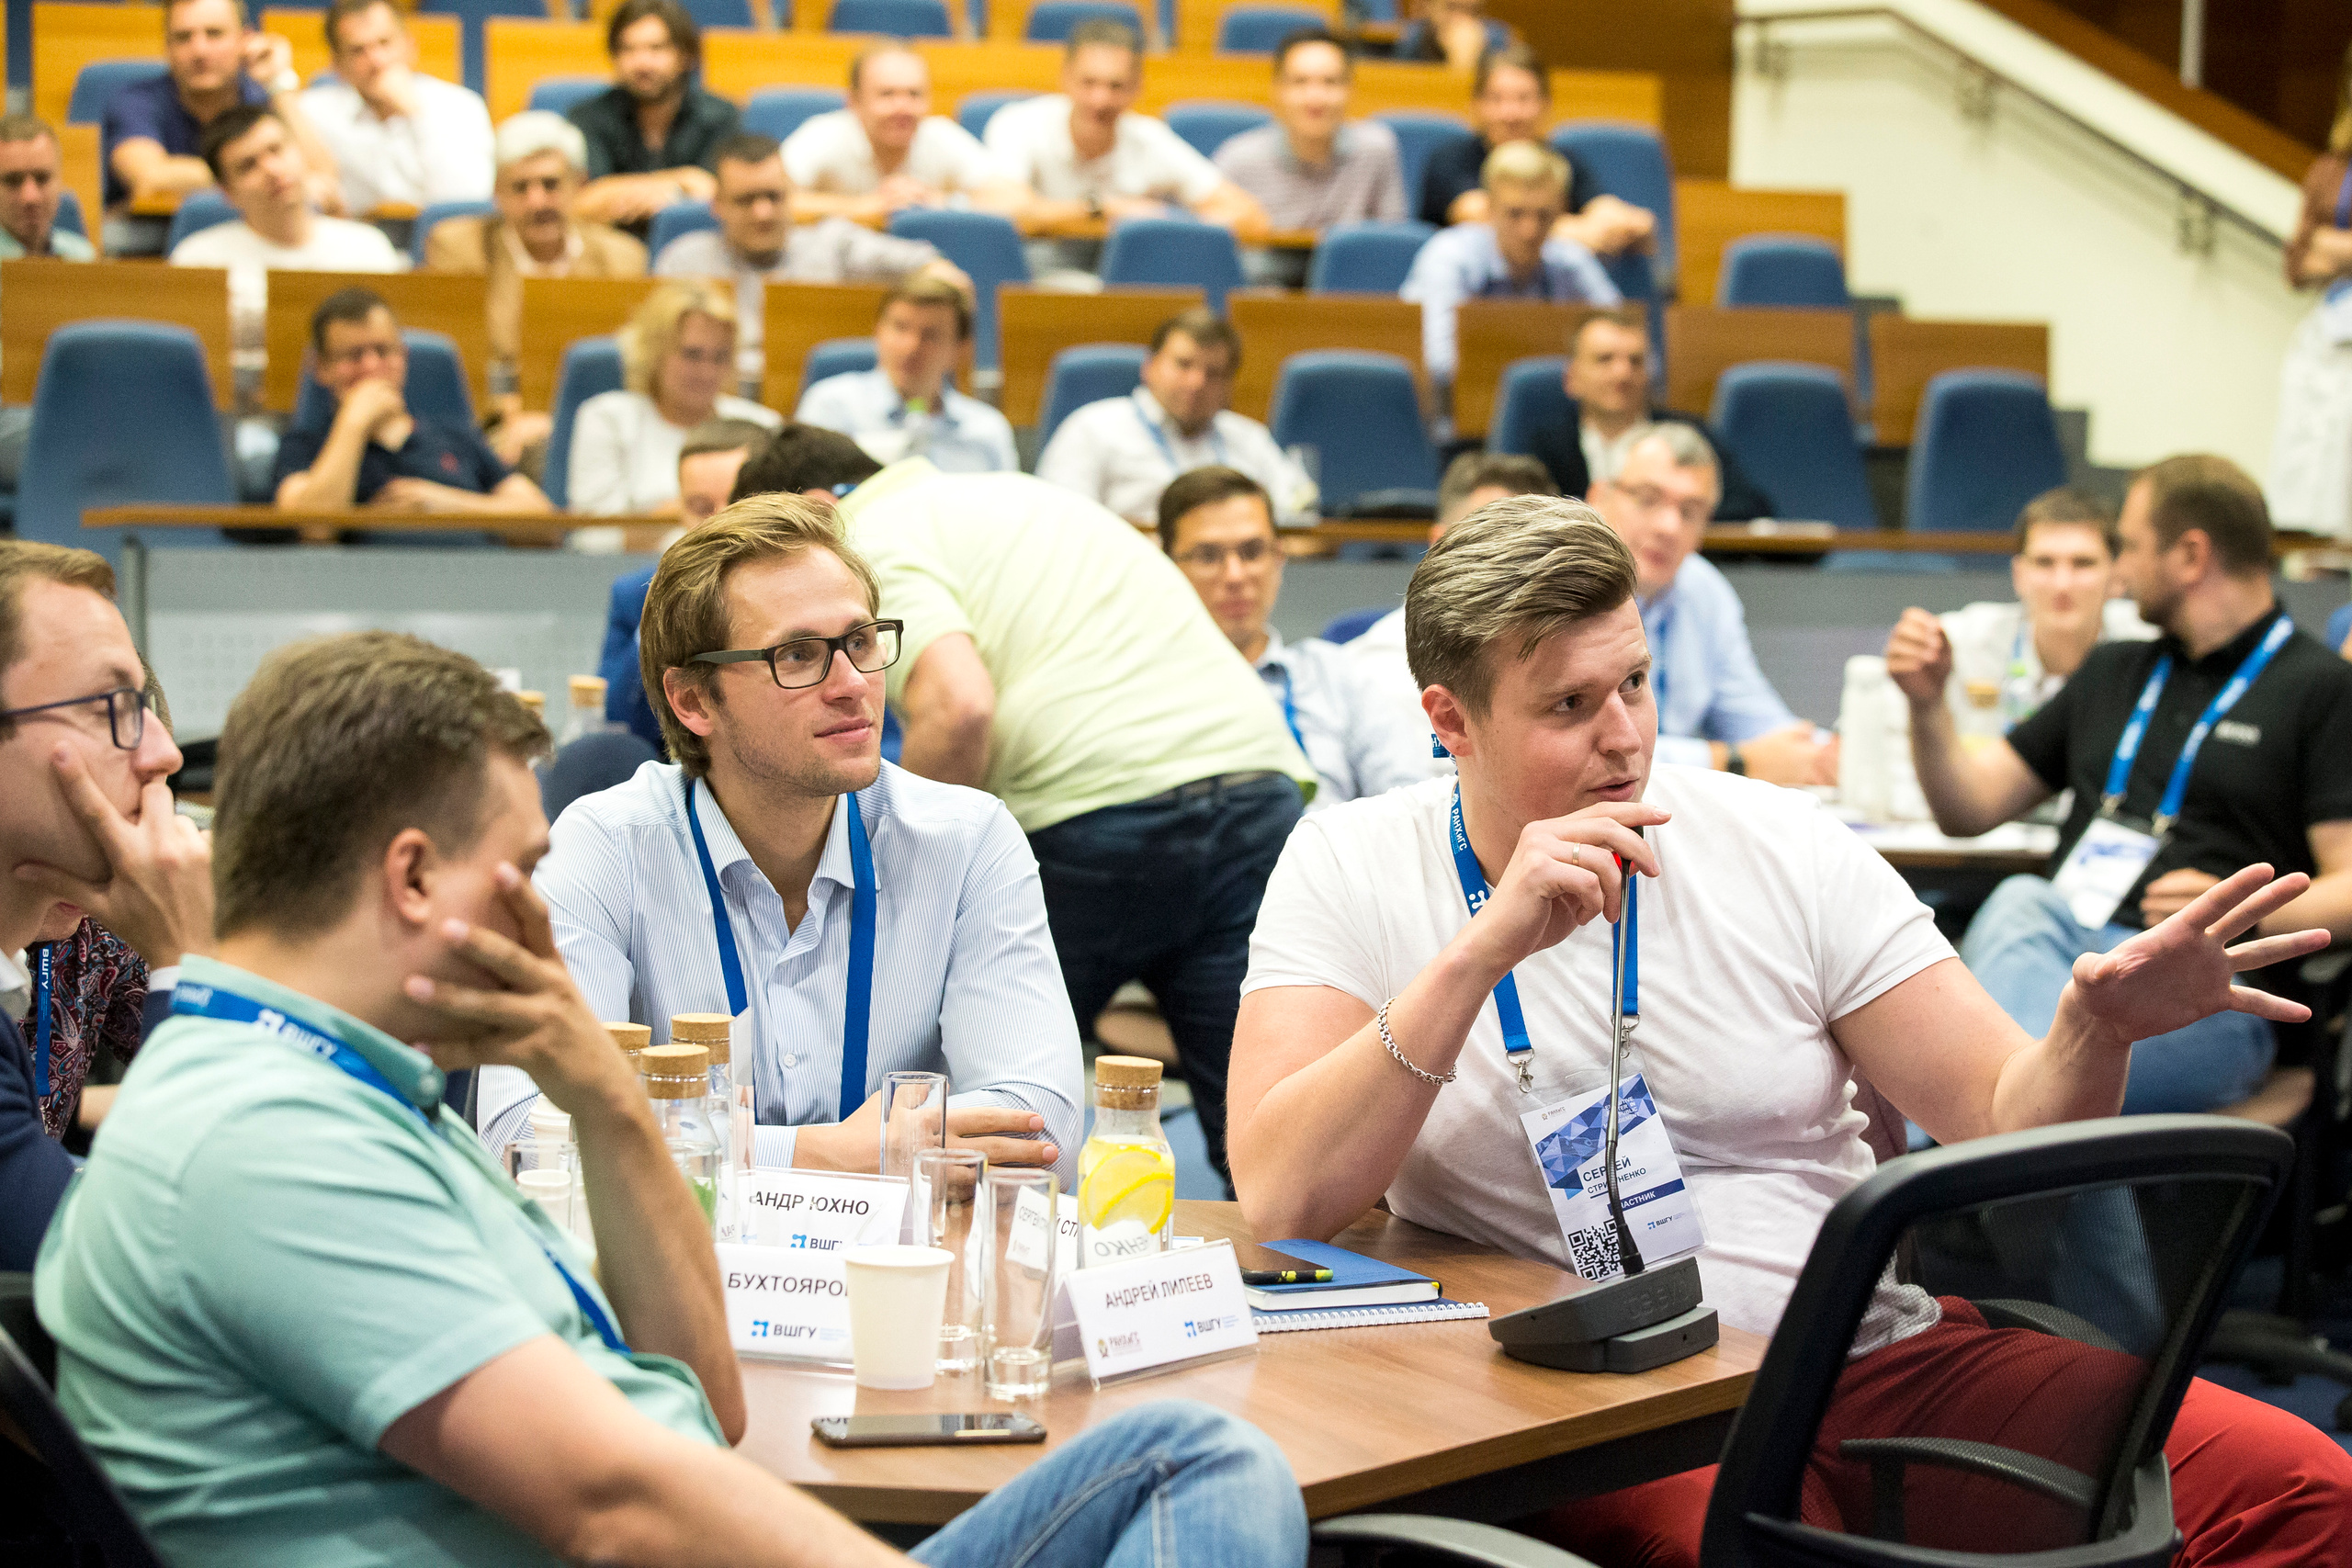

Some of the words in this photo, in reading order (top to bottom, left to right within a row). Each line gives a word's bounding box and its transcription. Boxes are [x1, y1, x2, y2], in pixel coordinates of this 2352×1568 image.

[1452, 807, 1467, 852] РАНХиГС
[41, 948, 50, 990] ВШГУ
[1582, 1156, 1632, 1182] СЕРЕЙ
[1587, 1168, 1646, 1194] СТРИНЕНКО
[809, 1196, 869, 1215] ЮХНО
[1621, 1190, 1657, 1209] АСТНИК
[728, 1272, 848, 1296] БУХТОЯРО
[1105, 1280, 1159, 1309] АНДРЕЙ
[1161, 1273, 1214, 1298] ЛИЛЕЕВ
[773, 1324, 817, 1338] ВШГУ
[1197, 1318, 1221, 1333] ВШГУ
